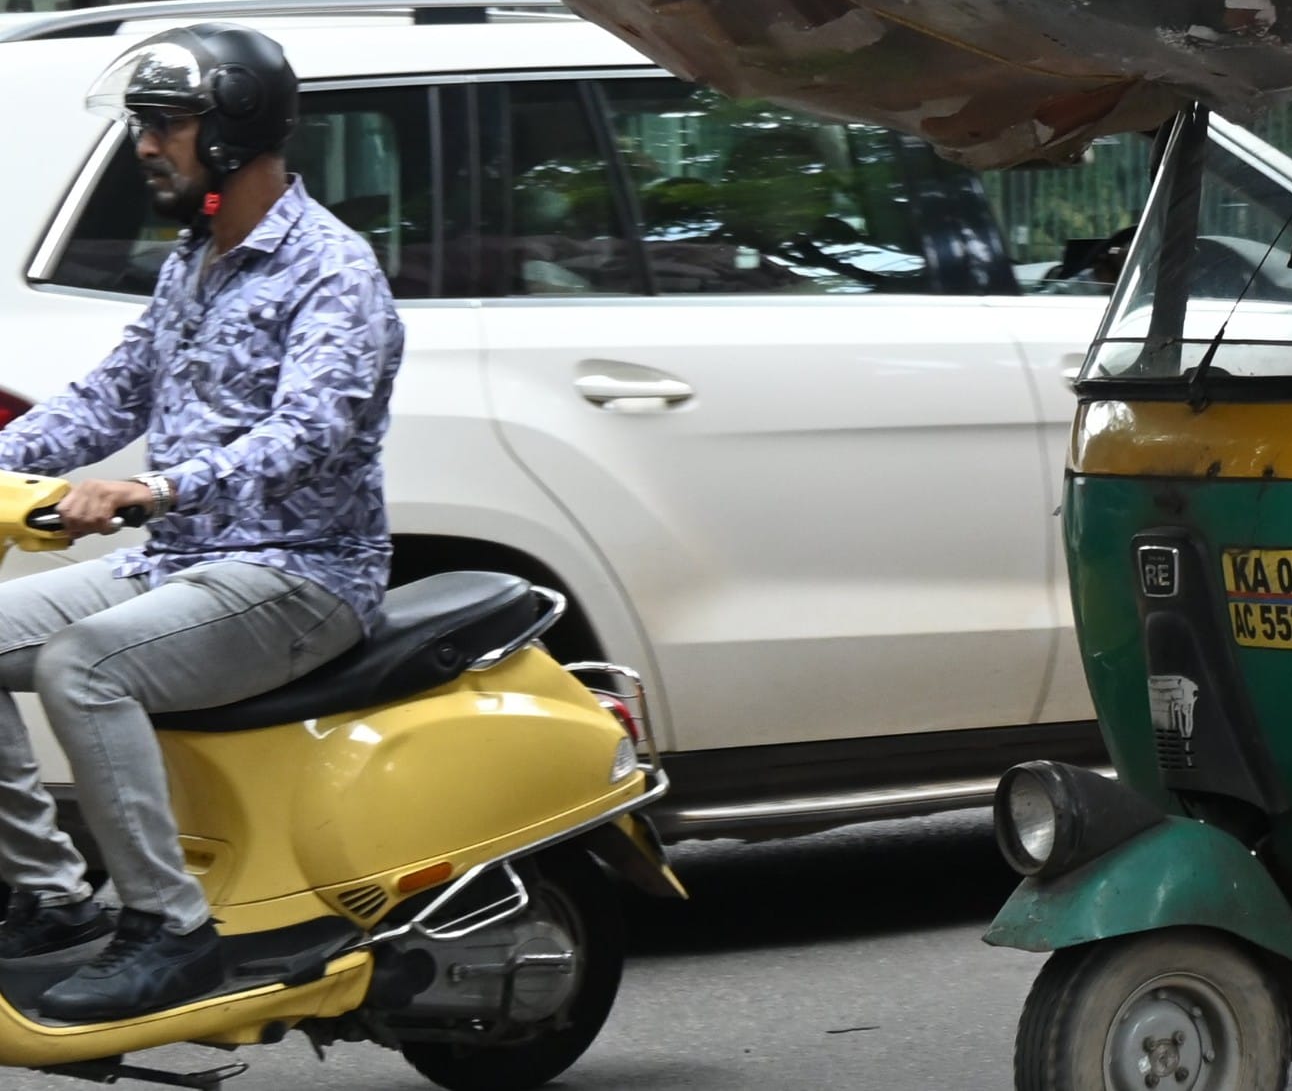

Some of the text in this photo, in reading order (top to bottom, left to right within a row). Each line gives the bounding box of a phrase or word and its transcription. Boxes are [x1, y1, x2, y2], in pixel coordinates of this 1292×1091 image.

[1144, 564, 1170, 586] RE
[1231, 556, 1271, 594] KA
[1234, 604, 1256, 639] AC
